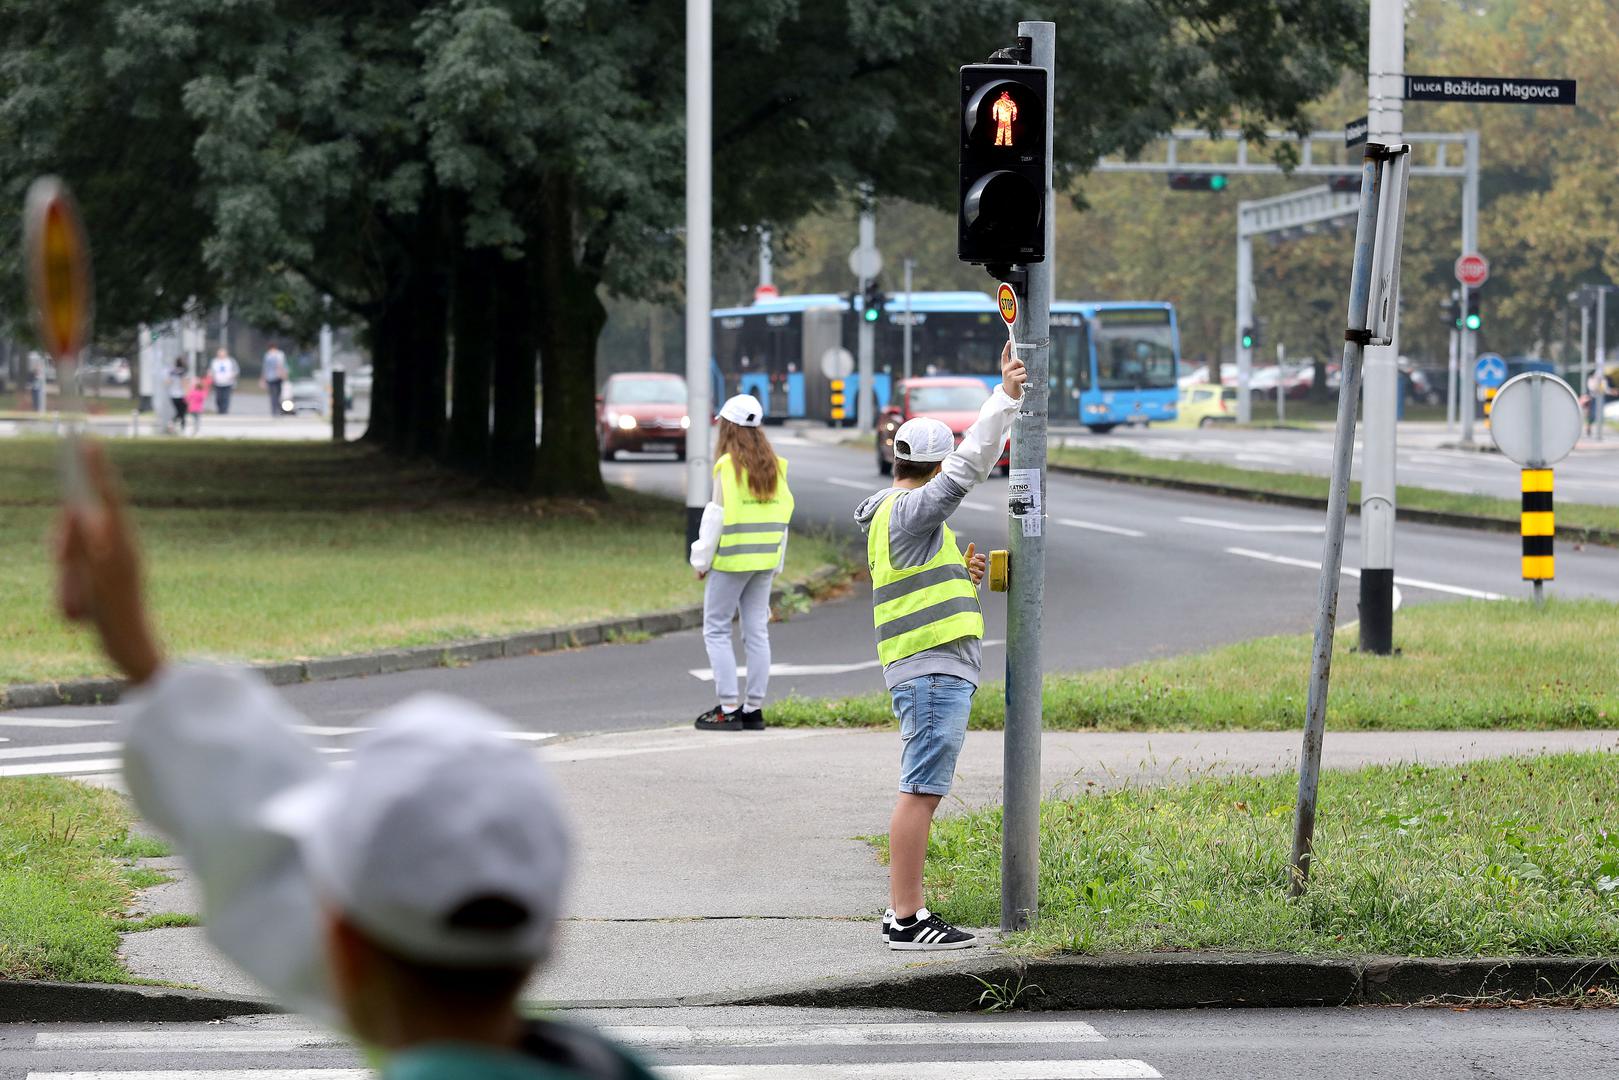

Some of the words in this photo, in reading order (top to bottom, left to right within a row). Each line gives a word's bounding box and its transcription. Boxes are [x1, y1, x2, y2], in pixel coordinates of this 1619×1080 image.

[1413, 82, 1442, 93] ULICA
[1444, 80, 1500, 97] Božidara
[1502, 82, 1560, 100] Magovca
[1001, 298, 1014, 310] STOP
